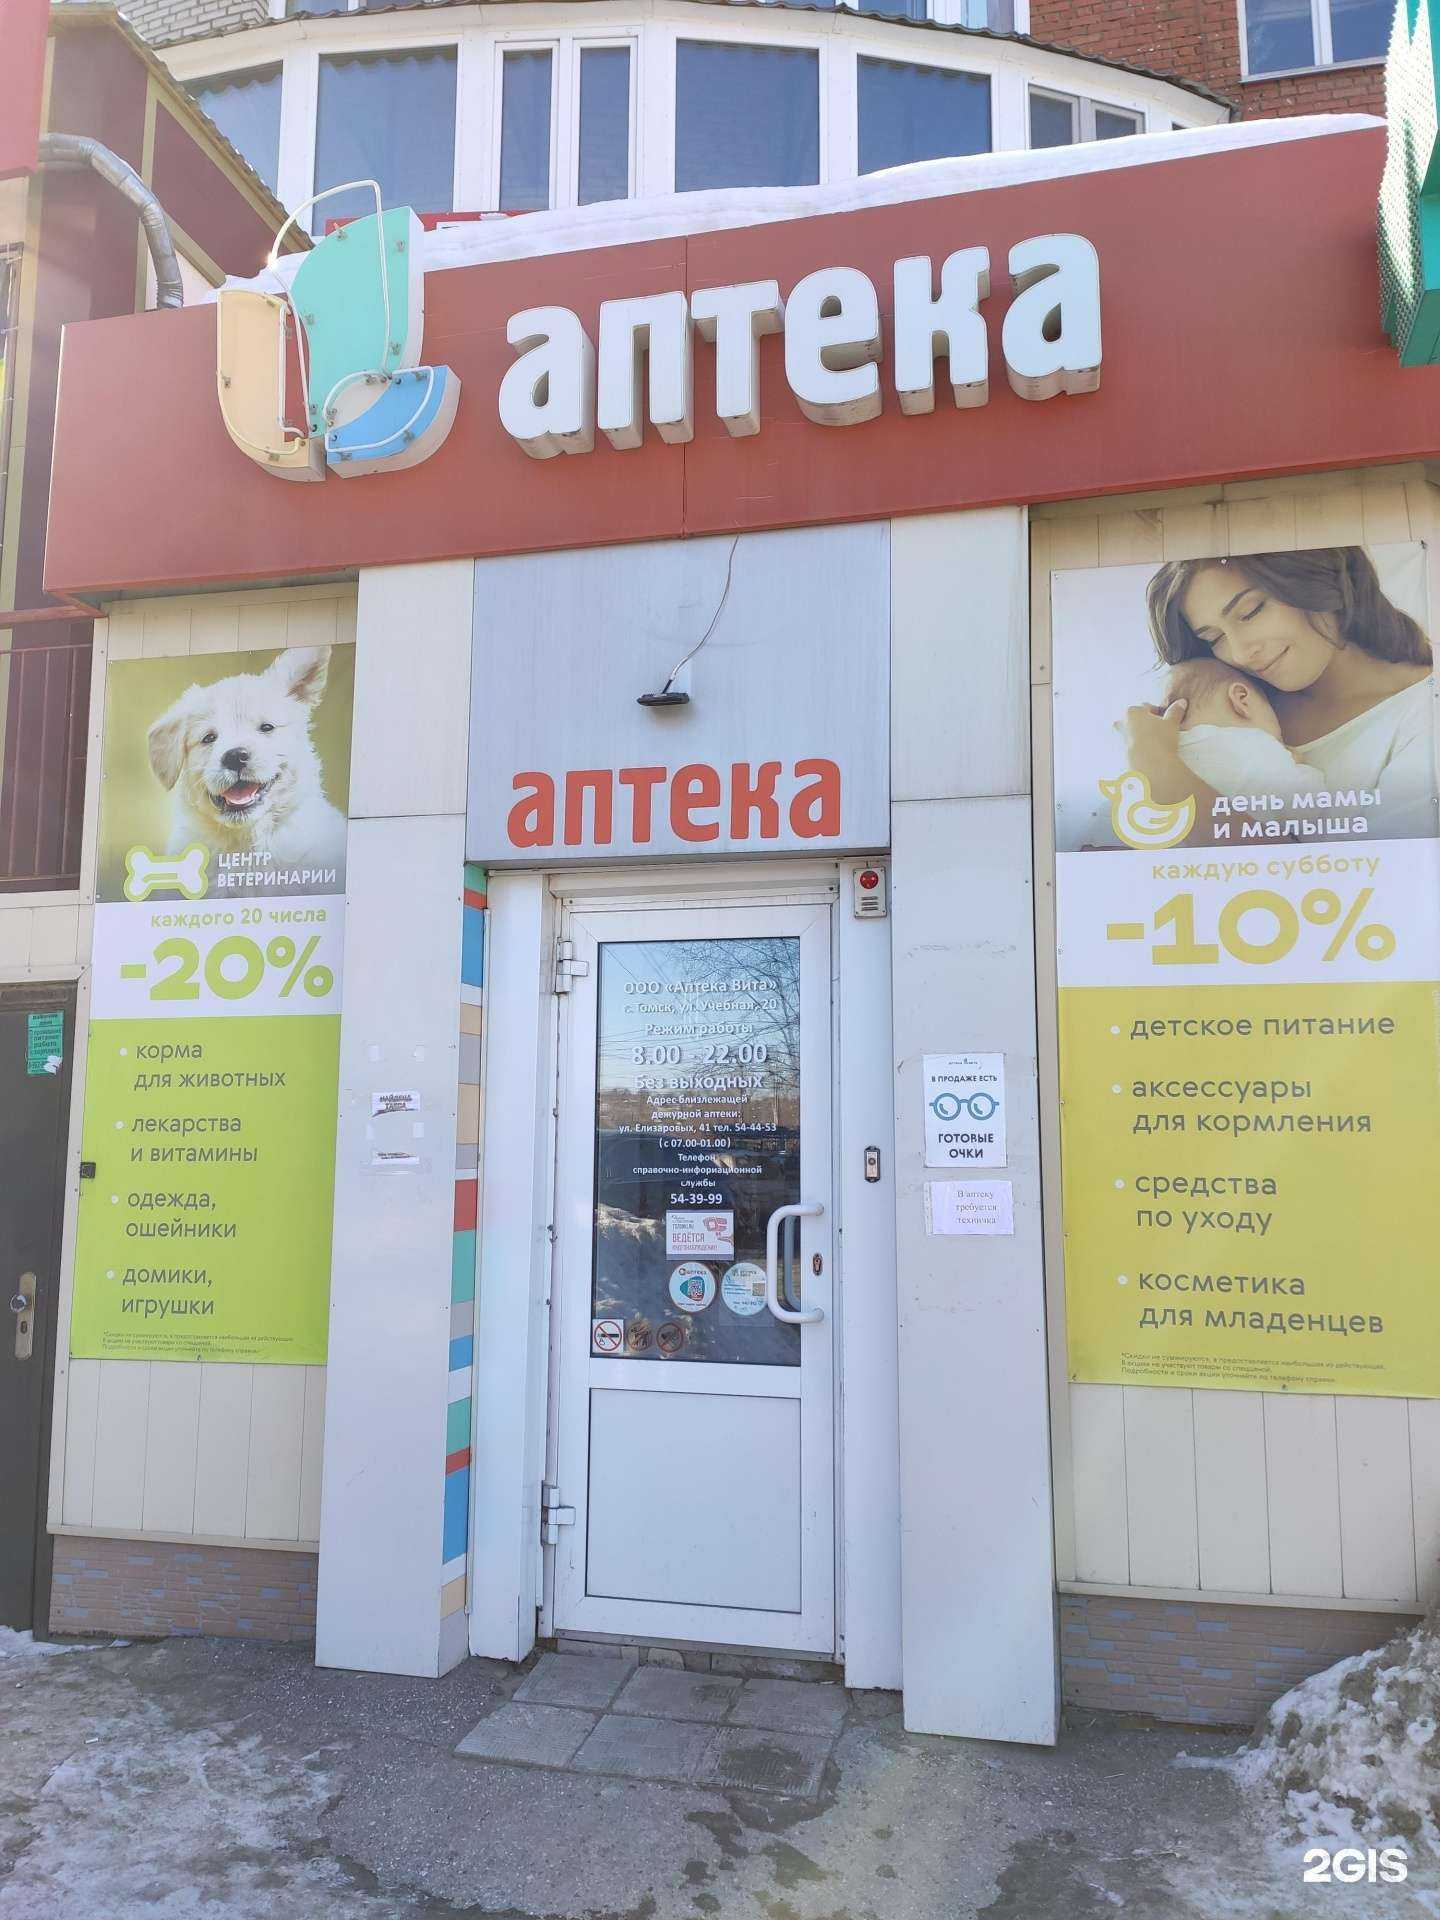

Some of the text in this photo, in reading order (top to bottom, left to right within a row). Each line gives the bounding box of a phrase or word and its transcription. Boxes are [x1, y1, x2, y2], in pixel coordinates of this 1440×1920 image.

[499, 234, 1103, 458] аптека
[506, 756, 841, 849] аптека
[1212, 788, 1382, 817] день мамы
[1214, 814, 1369, 839] и малыша
[217, 852, 272, 870] ЦЕНТР
[1152, 855, 1381, 883] каждую субботу
[217, 869, 336, 888] ВЕТЕРИНАРИИ
[152, 907, 327, 928] каждого 20 числа
[1106, 887, 1396, 965] -10%
[121, 935, 334, 1000] -20%
[624, 979, 777, 994] ООО «Аптека Вита»
[762, 999, 777, 1009] 20
[646, 1022, 753, 1036] Режим работы
[1130, 1016, 1396, 1040] детское питание
[136, 1043, 202, 1063] корма
[632, 1045, 681, 1065] 8.00
[703, 1044, 767, 1064] 22.00
[134, 1072, 286, 1091] для животных
[634, 1074, 763, 1091] Без выходных
[938, 1075, 977, 1083] ПРОДАЖЕ
[646, 1096, 676, 1106] Адрес
[1132, 1079, 1312, 1104] аксессуары
[652, 1110, 741, 1120] дежурной аптеки:
[1133, 1113, 1372, 1137] для кормления
[131, 1116, 242, 1137] лекарства
[618, 1126, 633, 1134] ул.
[635, 1124, 697, 1134] Елизаровых,
[699, 1123, 711, 1132] 41
[735, 1123, 777, 1132] 54-44-53
[938, 1133, 994, 1144] ГОТОВЫЕ
[131, 1146, 258, 1163] и витамины
[678, 1154, 716, 1163] Телефон
[949, 1149, 984, 1158] ОЧКИ
[680, 1178, 716, 1188] службы
[1135, 1174, 1278, 1199] средства
[127, 1192, 217, 1211] одежда,
[670, 1194, 723, 1205] 54-39-99
[125, 1218, 237, 1238] ошейники
[1137, 1209, 1273, 1236] по уходу
[122, 1268, 213, 1287] домики,
[1139, 1272, 1306, 1296] косметика
[121, 1297, 215, 1319] игрушки
[1139, 1308, 1384, 1336] для младенцев
